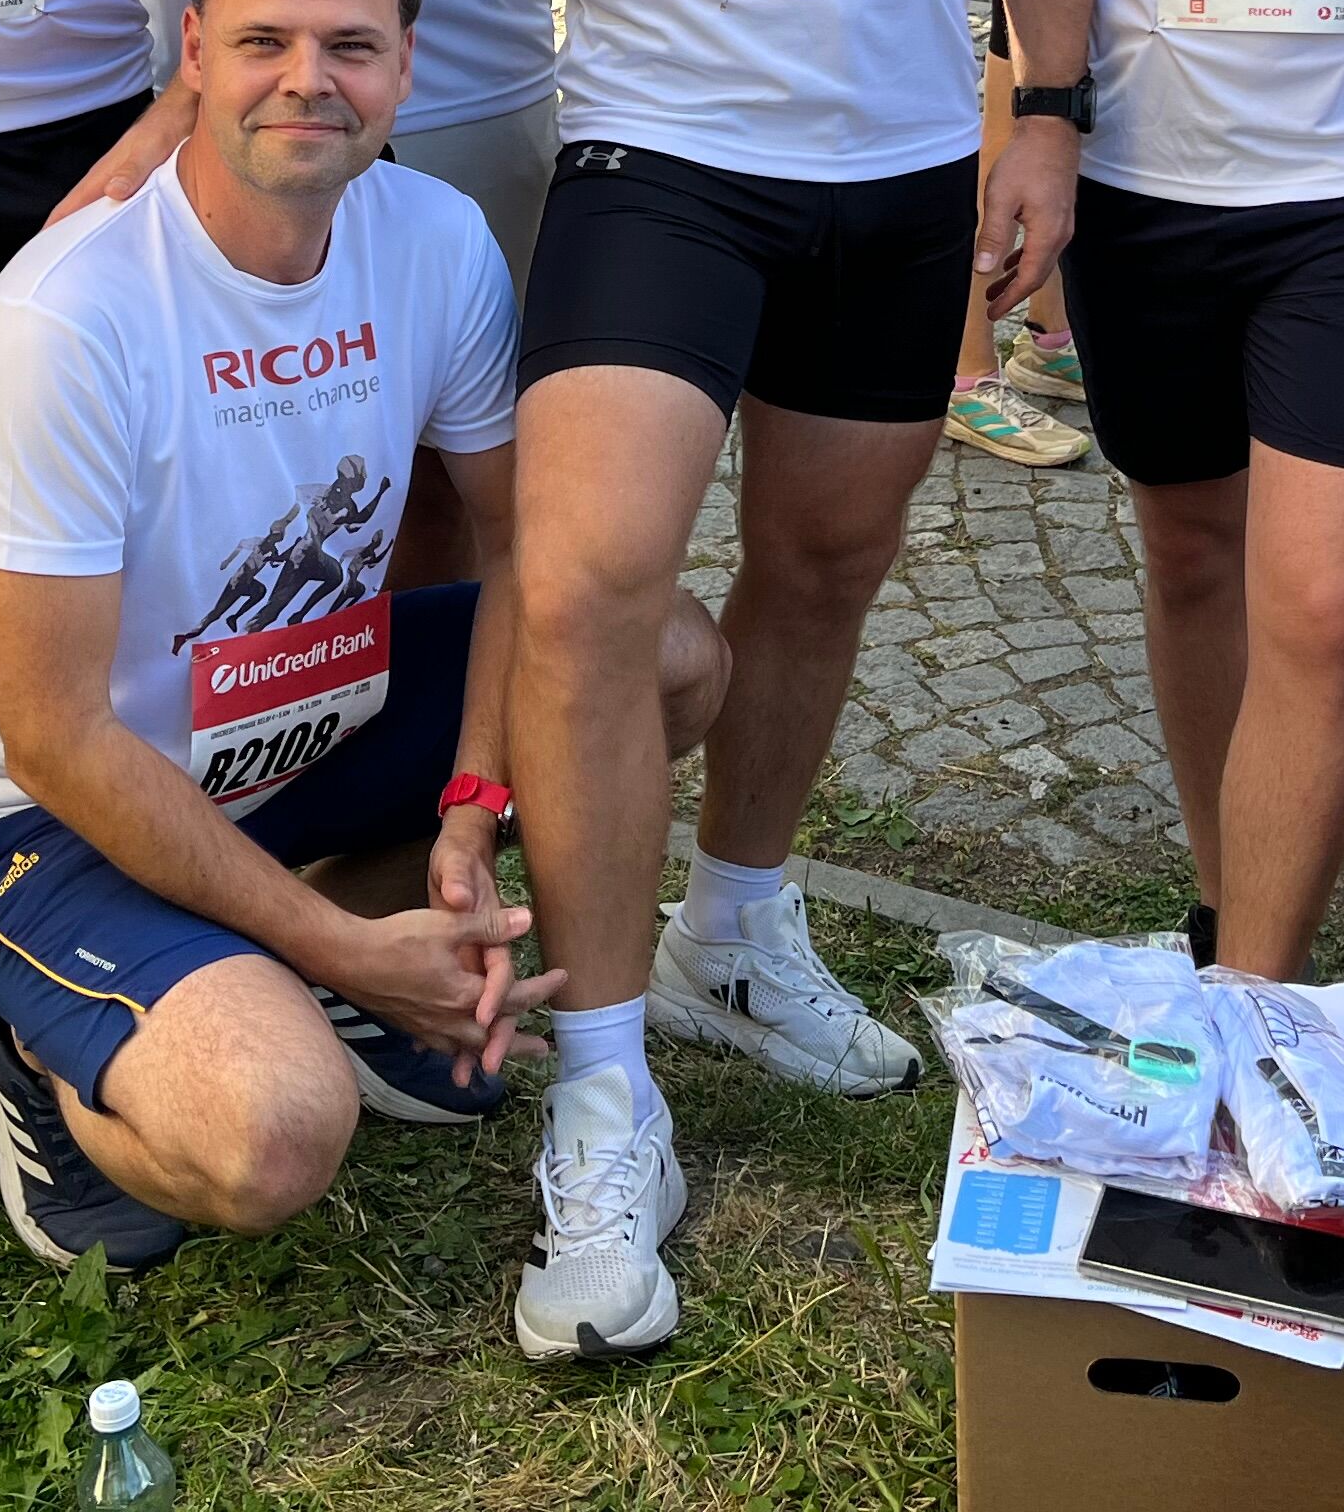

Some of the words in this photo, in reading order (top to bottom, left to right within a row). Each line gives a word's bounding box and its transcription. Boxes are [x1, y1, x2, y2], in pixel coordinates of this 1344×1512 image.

[1248, 8, 1292, 17] RICOH
[203, 322, 377, 395] RICOH
[238, 643, 329, 687] UniCredit
[331, 624, 376, 661] Bank
[200, 712, 341, 797] R2108
